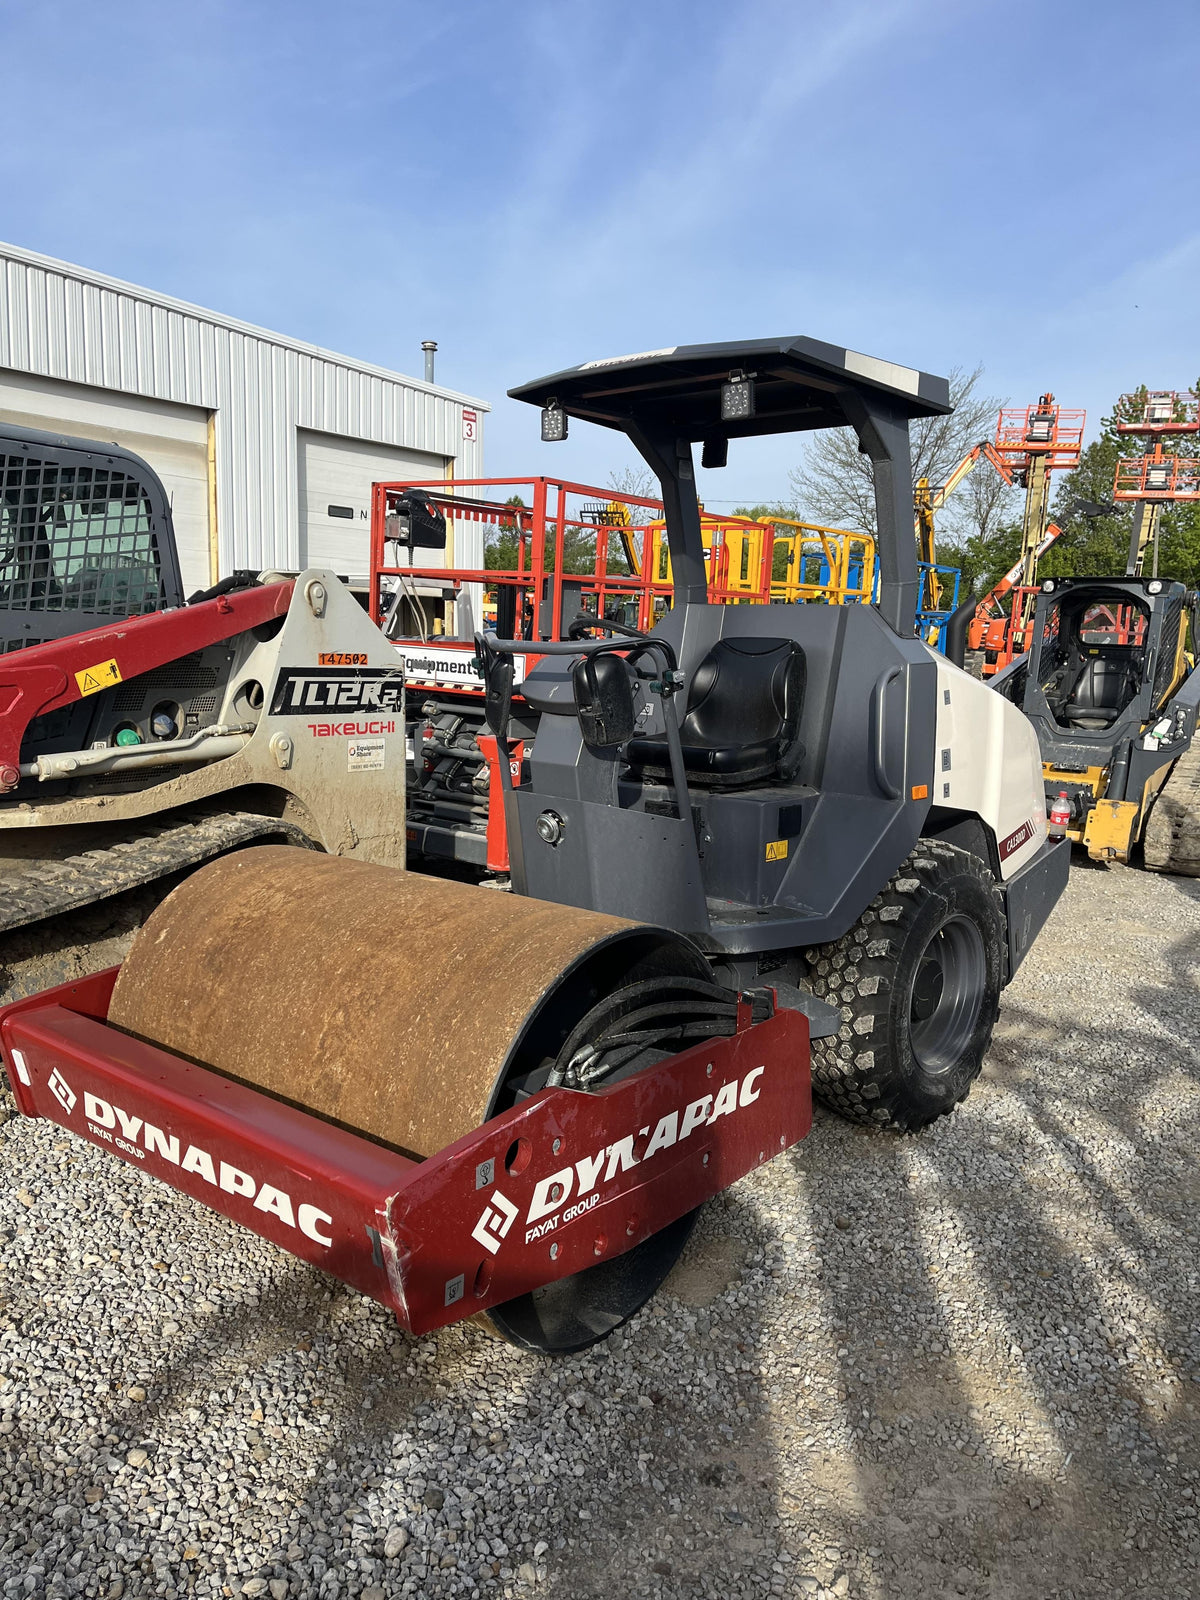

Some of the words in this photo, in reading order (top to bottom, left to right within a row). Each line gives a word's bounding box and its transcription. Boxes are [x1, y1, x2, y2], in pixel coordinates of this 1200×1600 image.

[466, 423, 473, 438] 3
[360, 510, 368, 521] N
[320, 653, 368, 665] 147502
[307, 721, 395, 737] TAKEUCHI
[356, 744, 384, 752] Equipment
[87, 1123, 113, 1144] FAYAT
[115, 1137, 146, 1161] GROUP
[526, 1065, 765, 1225] DYNAPAC
[83, 1091, 333, 1248] DYNAPAC
[525, 1214, 559, 1244] FAYAT
[562, 1194, 600, 1221] GROUP
